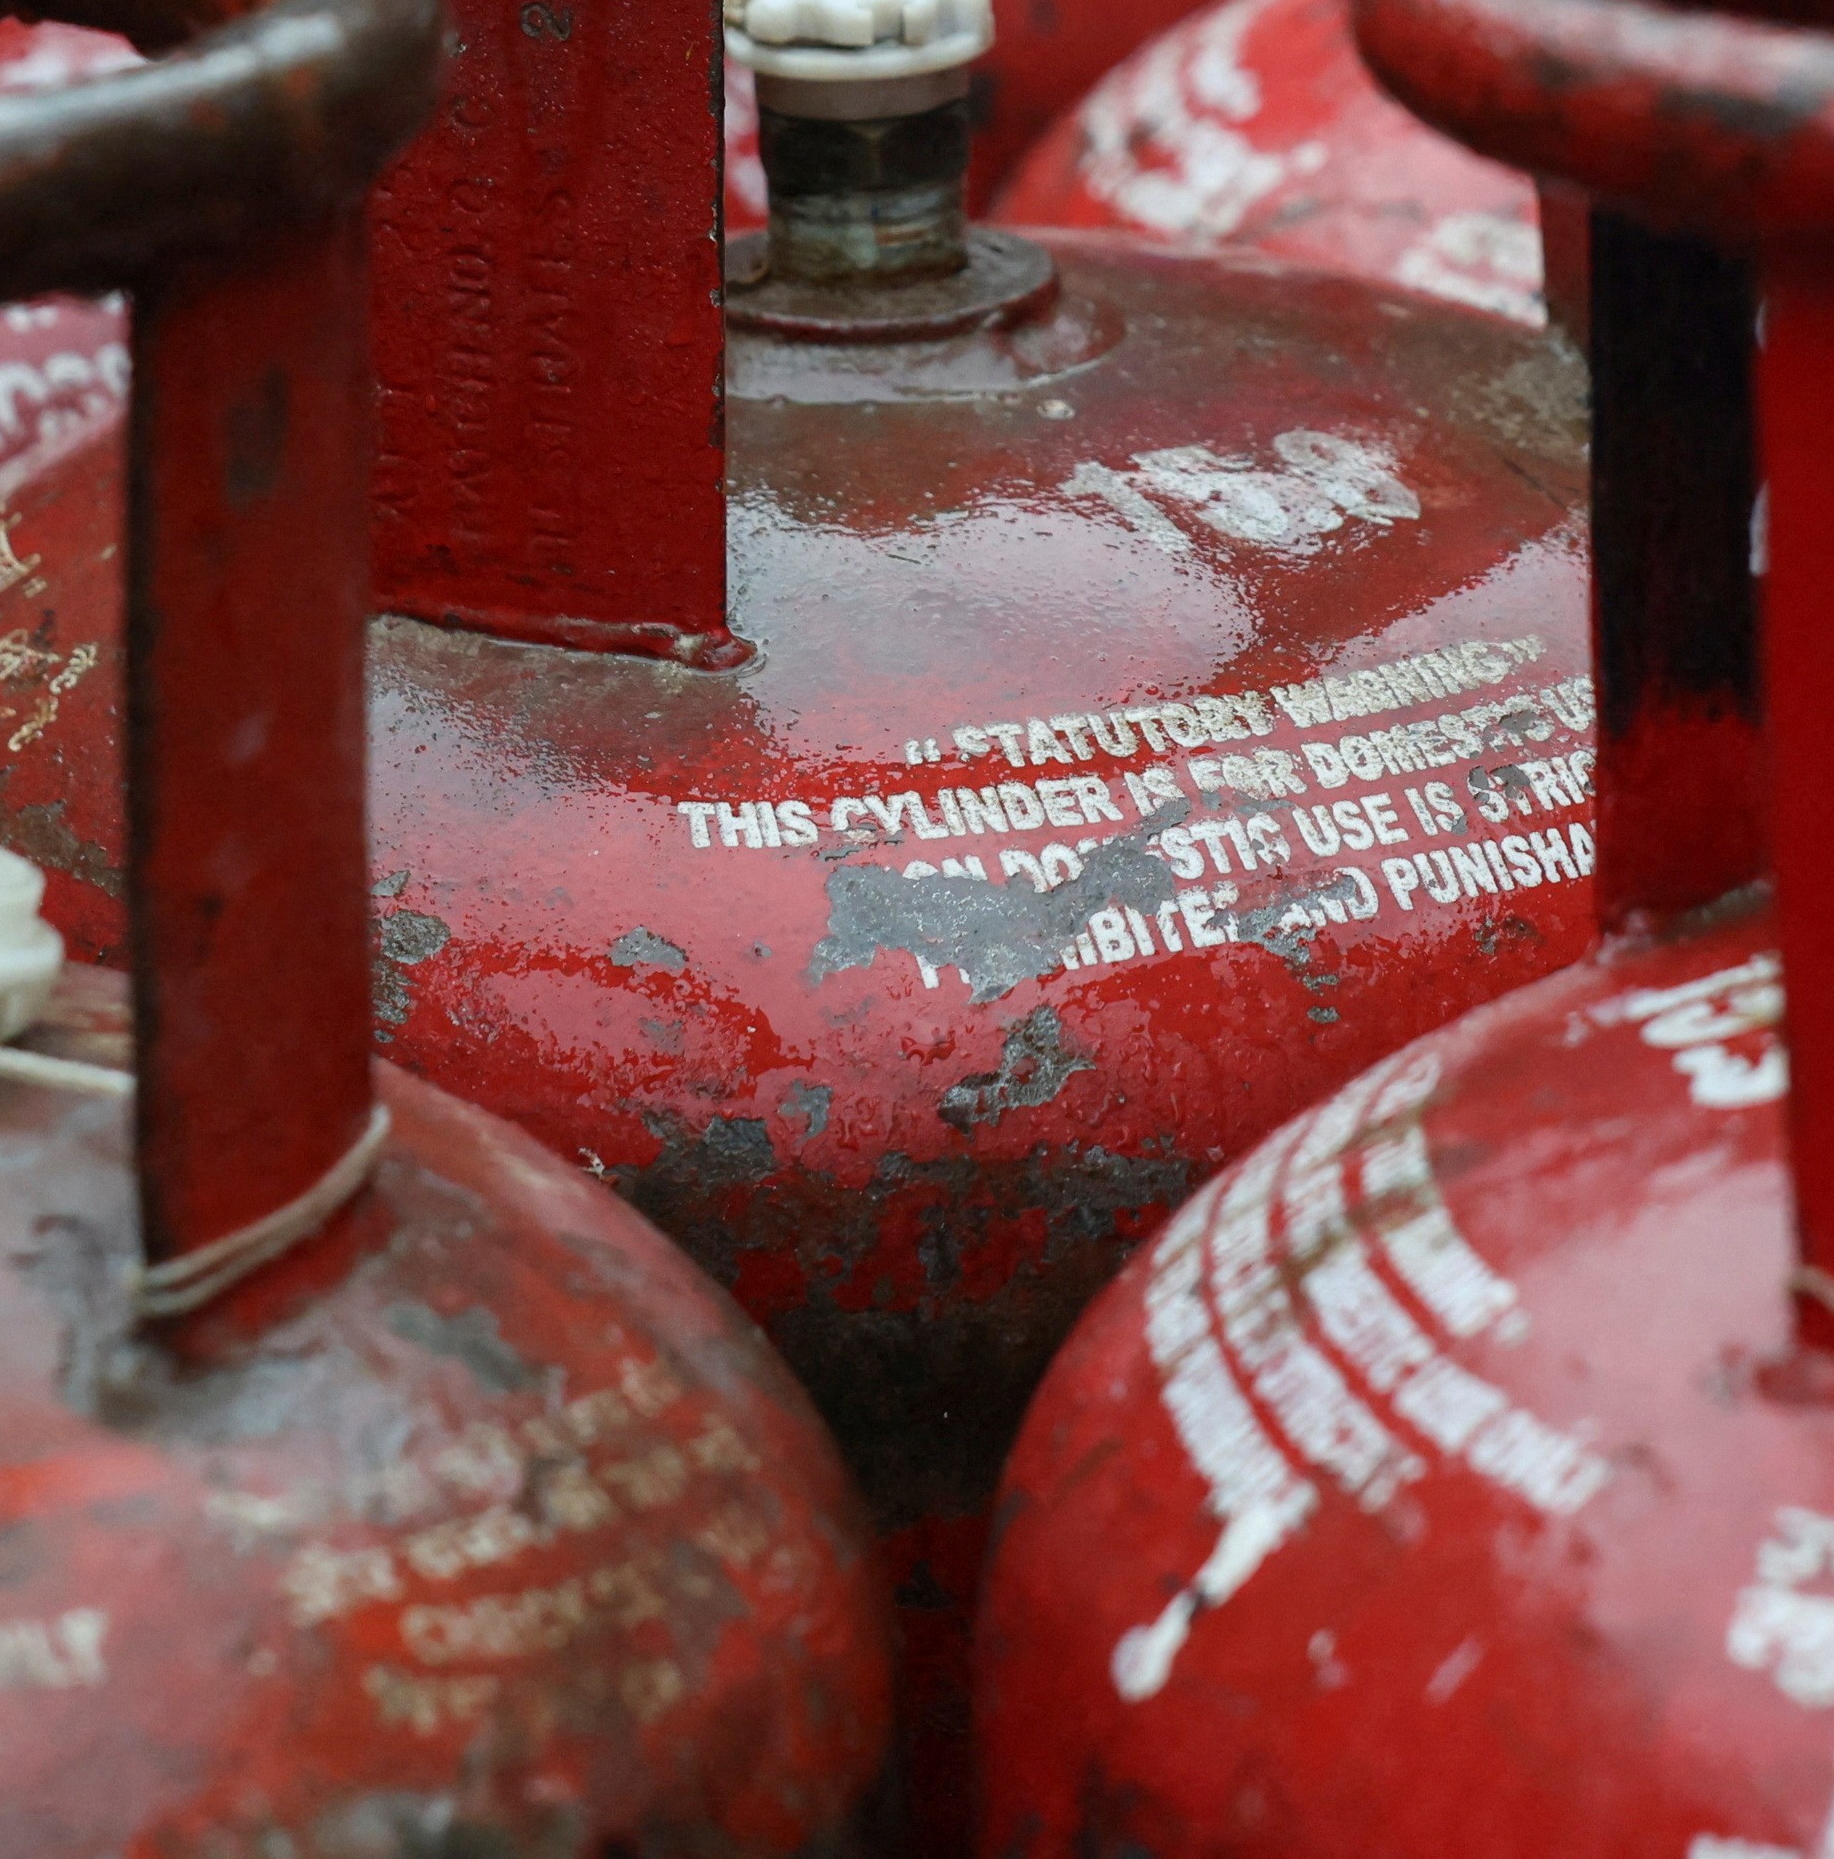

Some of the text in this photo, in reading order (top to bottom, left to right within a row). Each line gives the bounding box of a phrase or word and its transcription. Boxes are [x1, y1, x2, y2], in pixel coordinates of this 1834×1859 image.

[678, 800, 820, 850] THIS
[829, 774, 1125, 844] CYLINDER
[1123, 764, 1185, 818] IS
[1187, 744, 1309, 802] FOR
[1539, 674, 1596, 734] US
[1291, 792, 1410, 859] USE
[1403, 779, 1471, 838] IS
[1466, 747, 1597, 825] STRIC
[1380, 822, 1597, 913] PUNISHA
